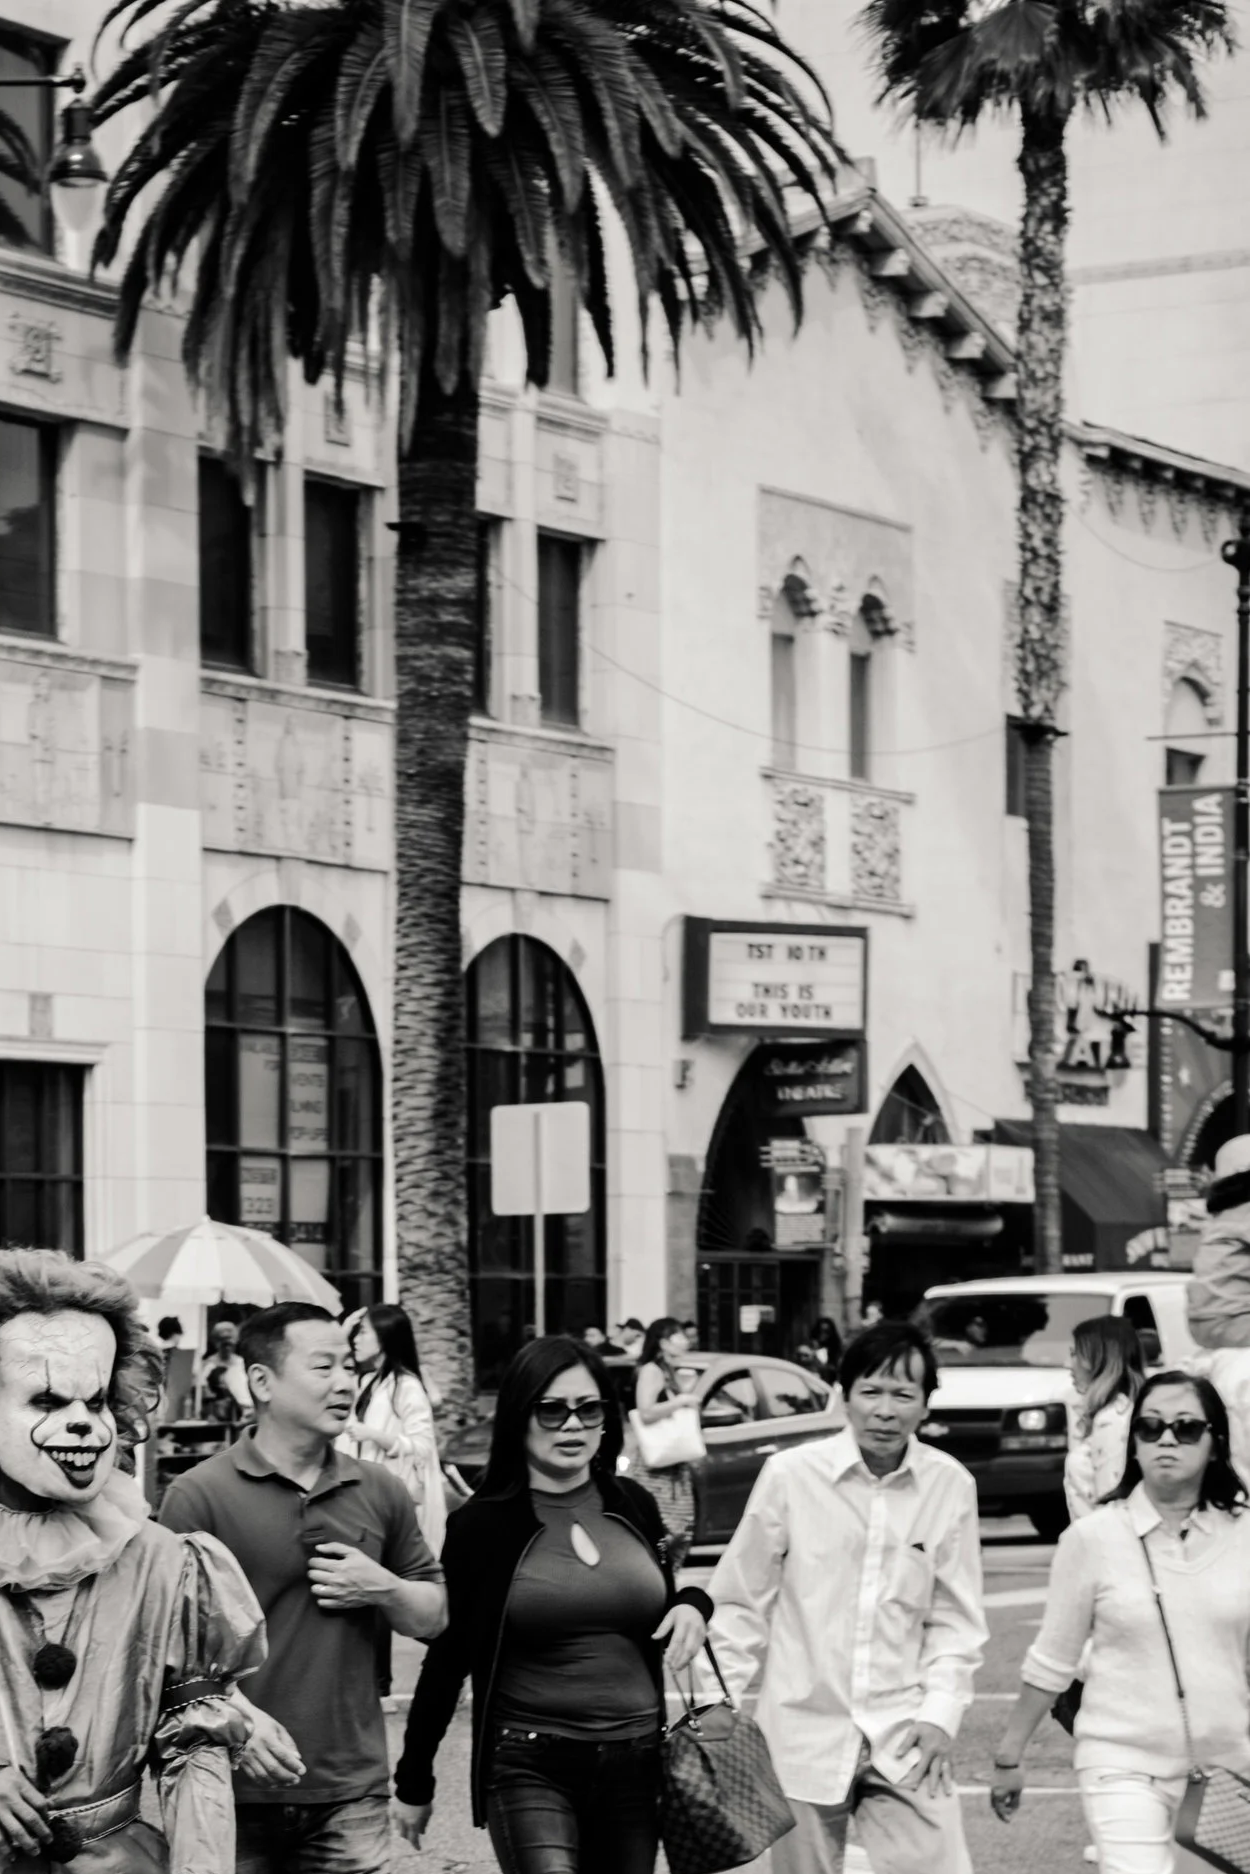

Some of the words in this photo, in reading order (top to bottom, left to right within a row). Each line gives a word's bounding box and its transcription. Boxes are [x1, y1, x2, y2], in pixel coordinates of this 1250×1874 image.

[1192, 793, 1225, 877] INDIA
[1161, 817, 1194, 1001] REMBRANDT
[1199, 883, 1226, 909] &
[753, 983, 789, 1000] THIS
[799, 984, 814, 1000] IS
[736, 1002, 769, 1019] OUR
[781, 1003, 833, 1020] YOUTH
